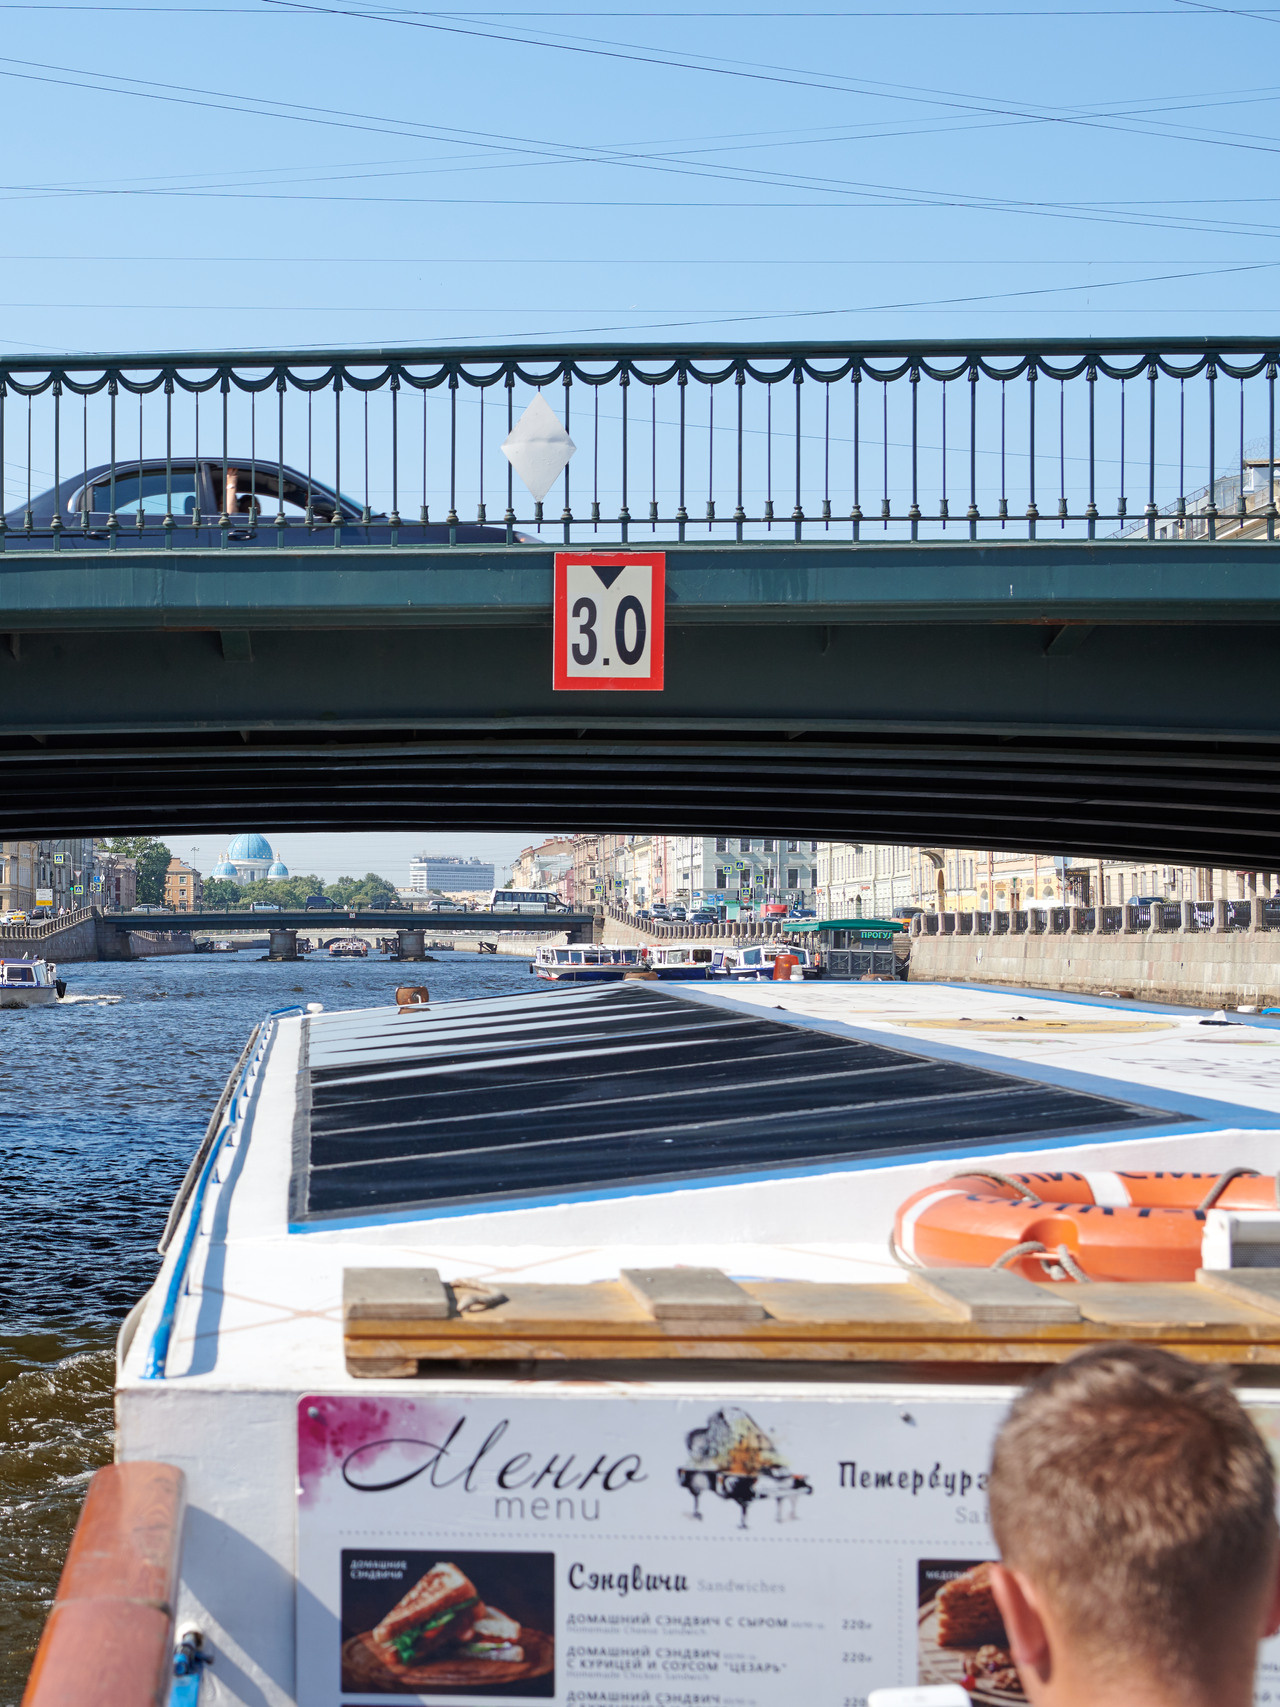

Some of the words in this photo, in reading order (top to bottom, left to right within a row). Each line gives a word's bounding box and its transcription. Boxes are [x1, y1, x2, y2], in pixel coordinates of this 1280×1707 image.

[572, 595, 646, 665] 3.0
[342, 1415, 648, 1492] Меню
[495, 1496, 600, 1521] menu
[568, 1562, 689, 1597] Сэндвичи
[696, 1579, 786, 1593] Sandwiches
[567, 1612, 650, 1625] ДОМАШНИЙ
[655, 1614, 720, 1626] СЭНДВИЧ
[725, 1617, 733, 1627] С
[738, 1617, 788, 1628] СЫРОМ
[567, 1645, 650, 1657] ДОМАШНИЙ
[655, 1647, 720, 1659] СЭНДВИЧ
[580, 1657, 642, 1671] КУРИЦЕЙ
[647, 1660, 657, 1670] И
[661, 1661, 718, 1671] СОУСОМ
[567, 1690, 650, 1702] ДОМАШНИЙ
[655, 1692, 720, 1704] СЭНДВИЧ
